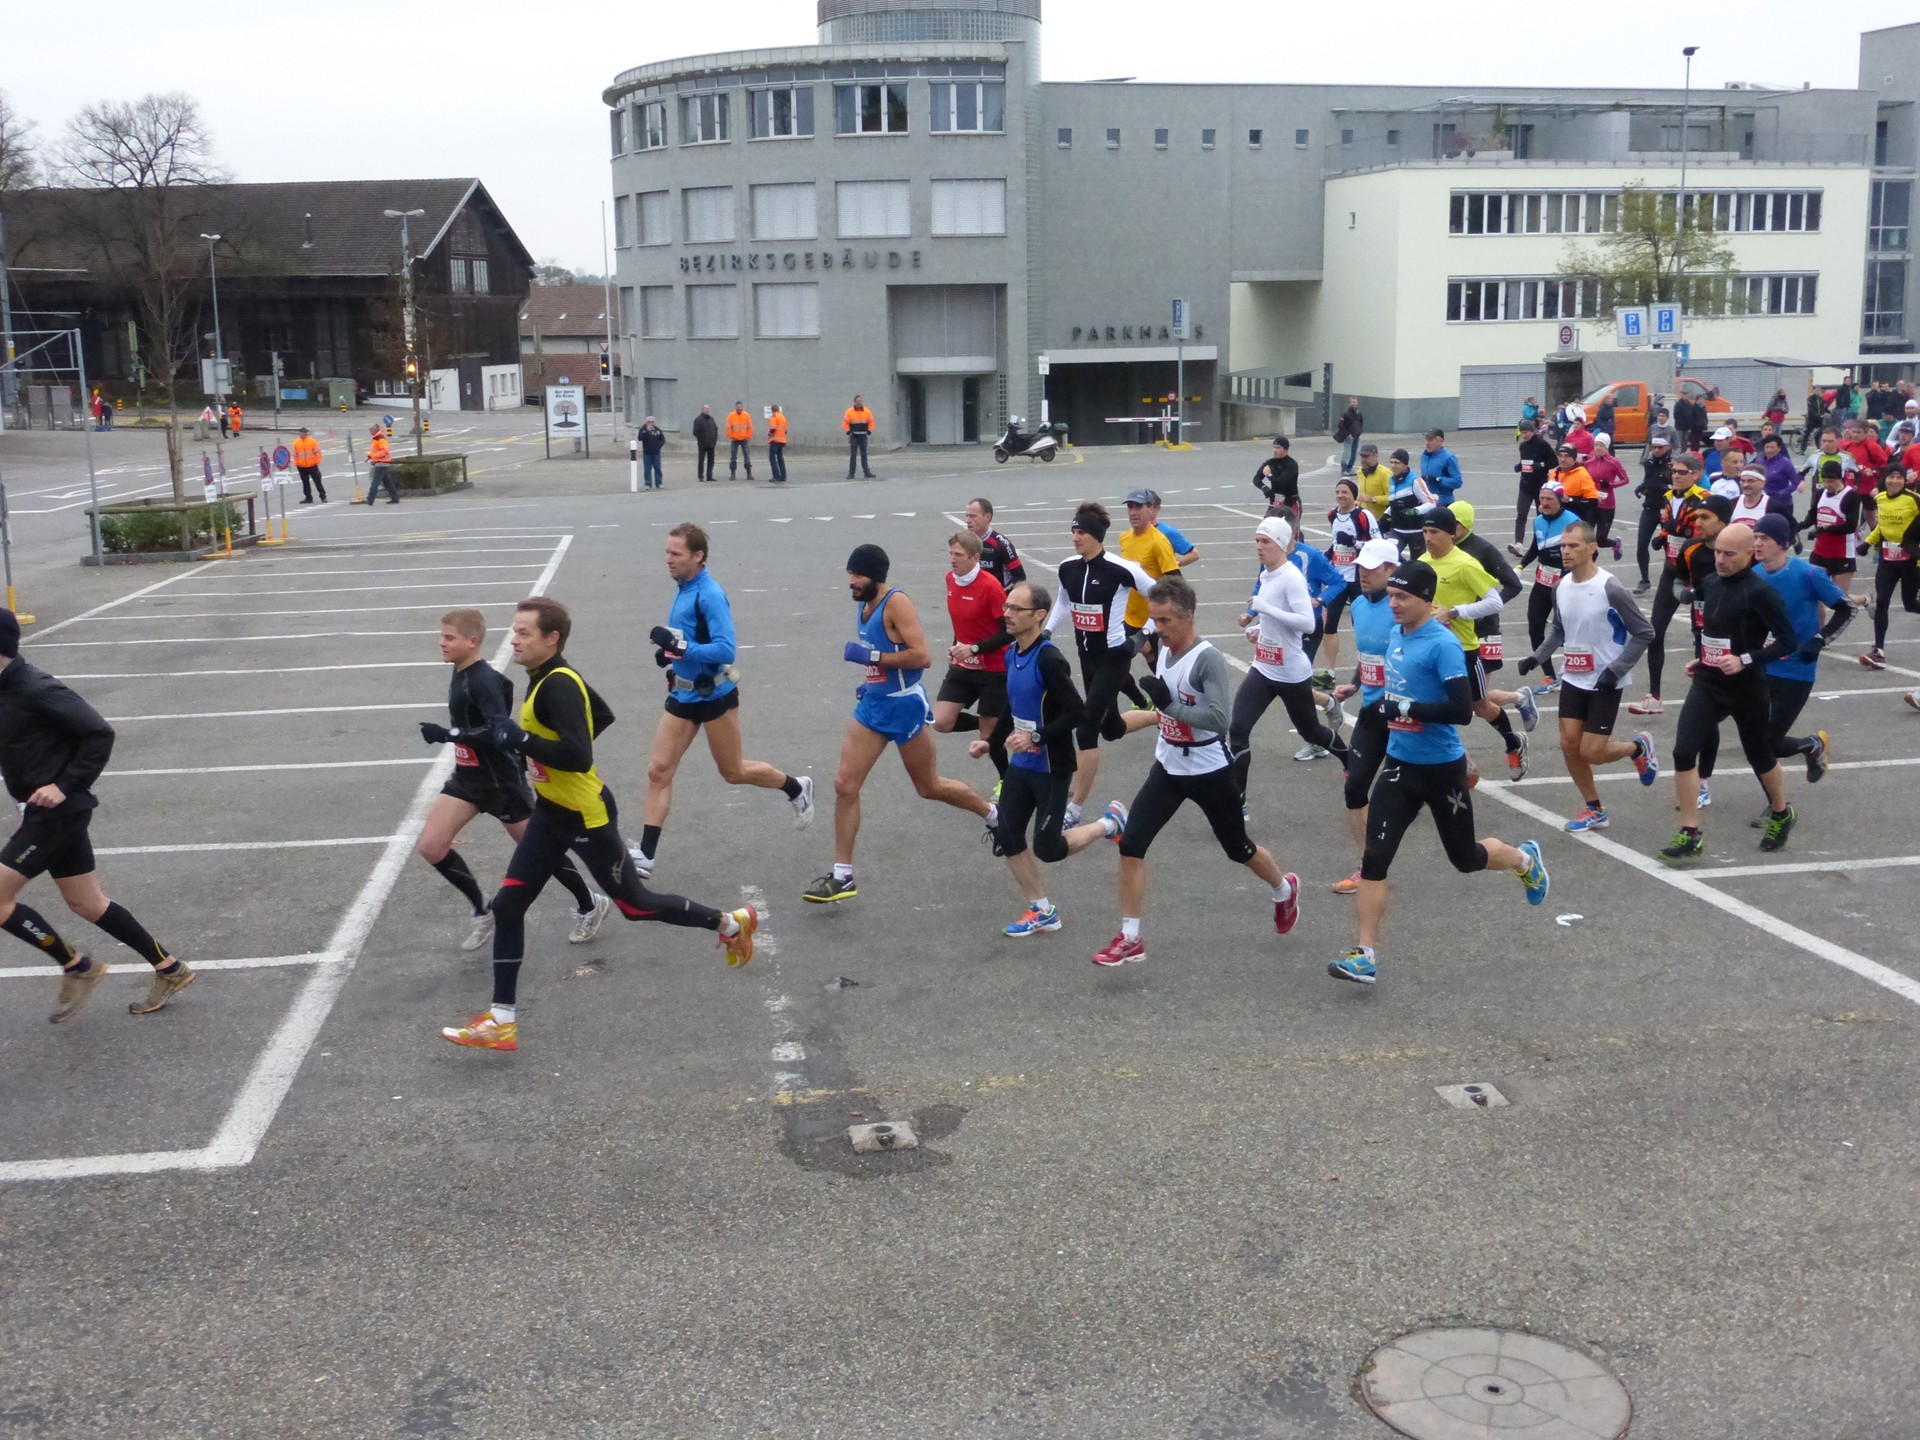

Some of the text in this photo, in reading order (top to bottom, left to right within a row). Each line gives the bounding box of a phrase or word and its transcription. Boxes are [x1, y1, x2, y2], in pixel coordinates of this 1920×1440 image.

[680, 248, 921, 273] BEZIRKSGEBÄUDE
[1072, 325, 1203, 341] PARKHAS
[1075, 614, 1097, 626] 7212
[1259, 650, 1275, 660] 7122
[1484, 645, 1502, 655] 717
